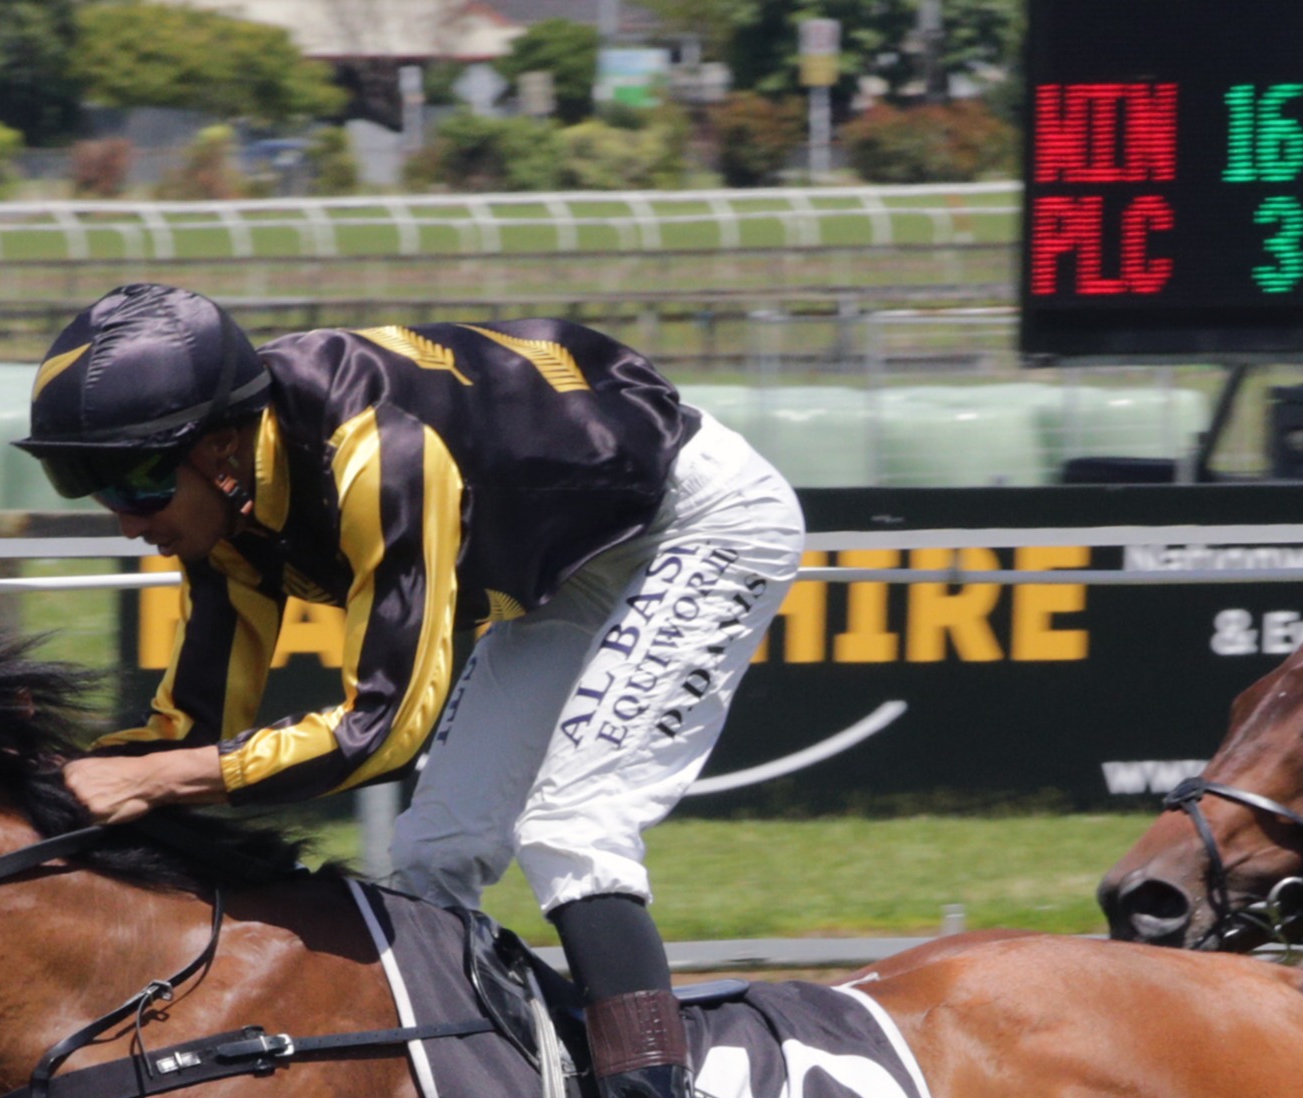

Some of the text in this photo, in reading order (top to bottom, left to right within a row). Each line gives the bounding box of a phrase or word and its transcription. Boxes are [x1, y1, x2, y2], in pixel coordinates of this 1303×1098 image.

[1035, 84, 1178, 182] WIN
[1032, 196, 1174, 294] PLC
[748, 545, 1091, 664] HIRE
[559, 670, 617, 750] AL
